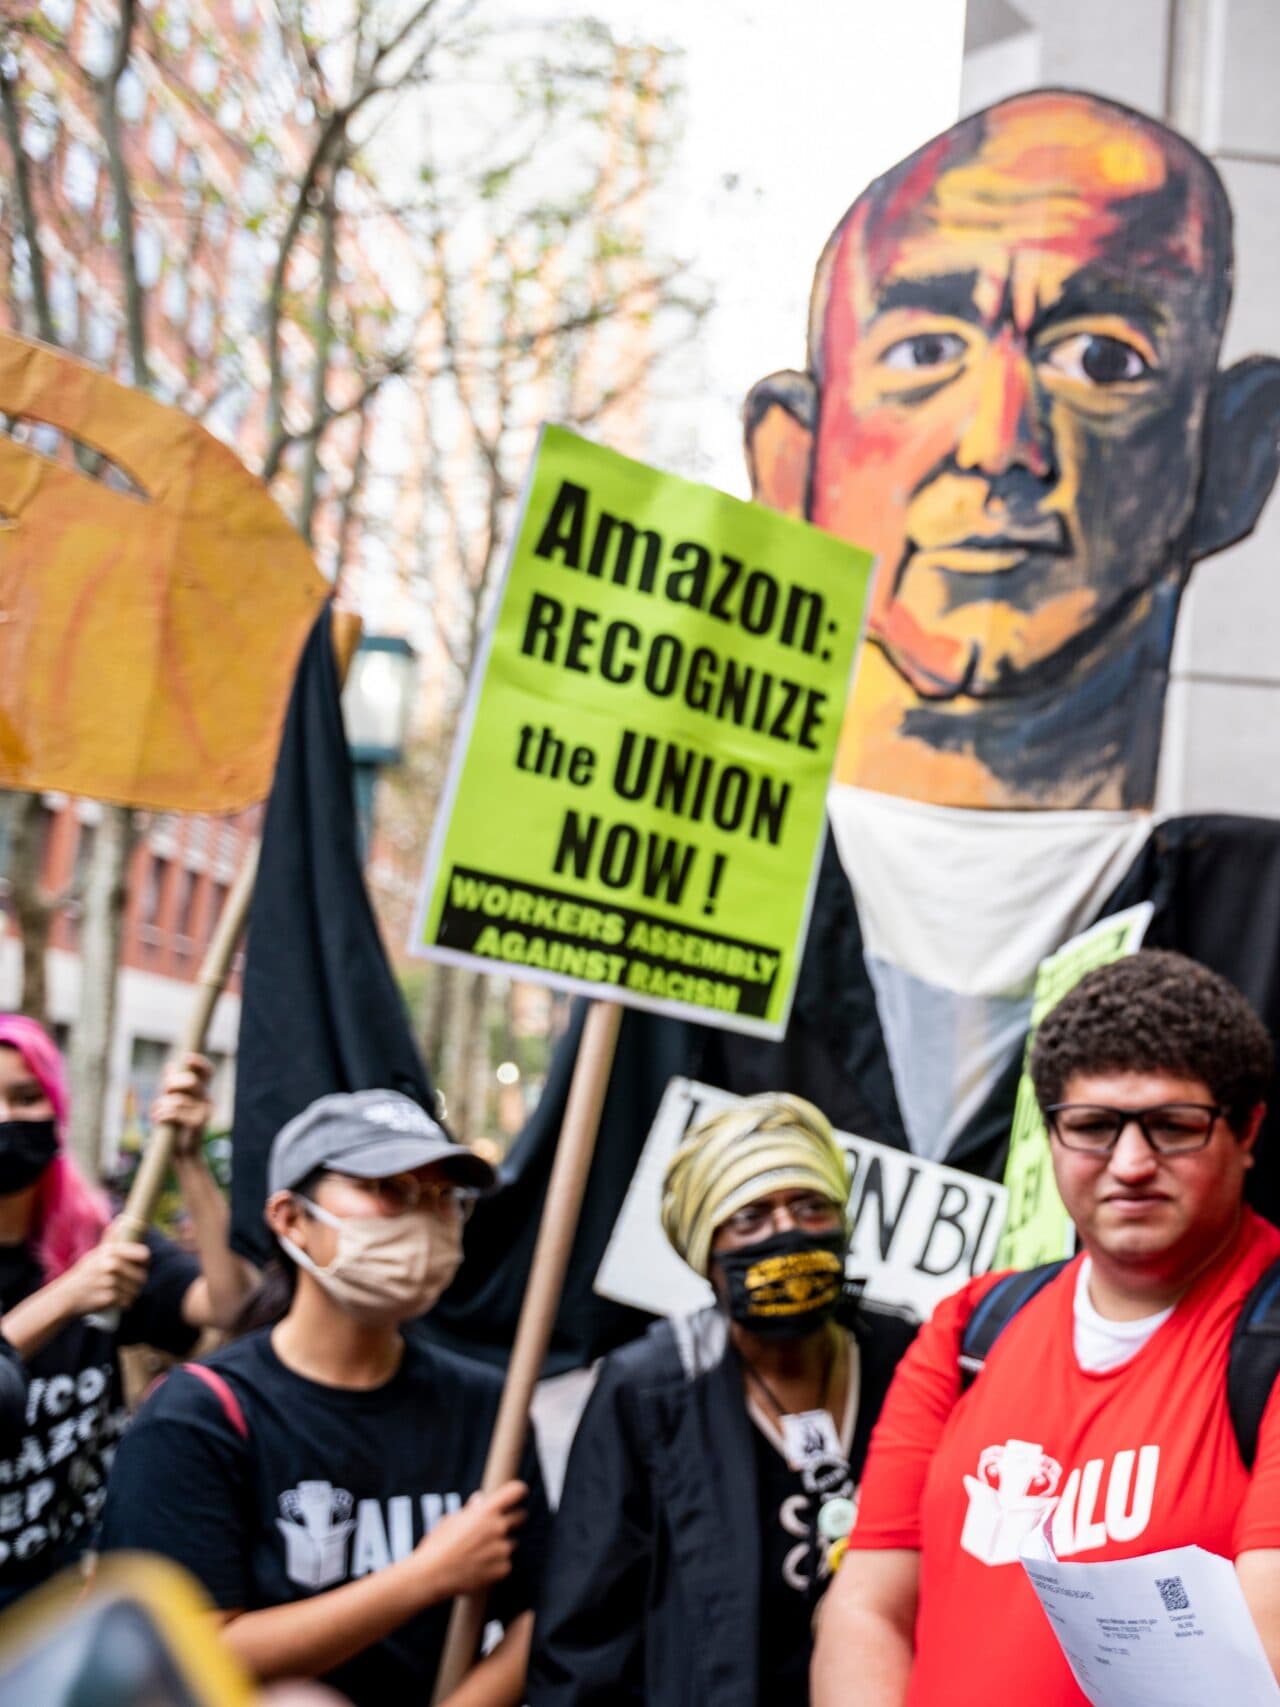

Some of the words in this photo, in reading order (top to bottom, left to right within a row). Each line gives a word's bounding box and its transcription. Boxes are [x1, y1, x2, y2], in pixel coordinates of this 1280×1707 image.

[534, 479, 838, 662] Amazon:
[520, 591, 828, 752] RECOGNIZE
[515, 724, 596, 786] the
[611, 730, 793, 847] UNION
[450, 873, 625, 946] WORKERS
[625, 920, 780, 986] ASSEMBLY
[473, 925, 625, 988] AGAINST
[629, 961, 740, 1014] RACISM
[1051, 1443, 1161, 1558] ALU
